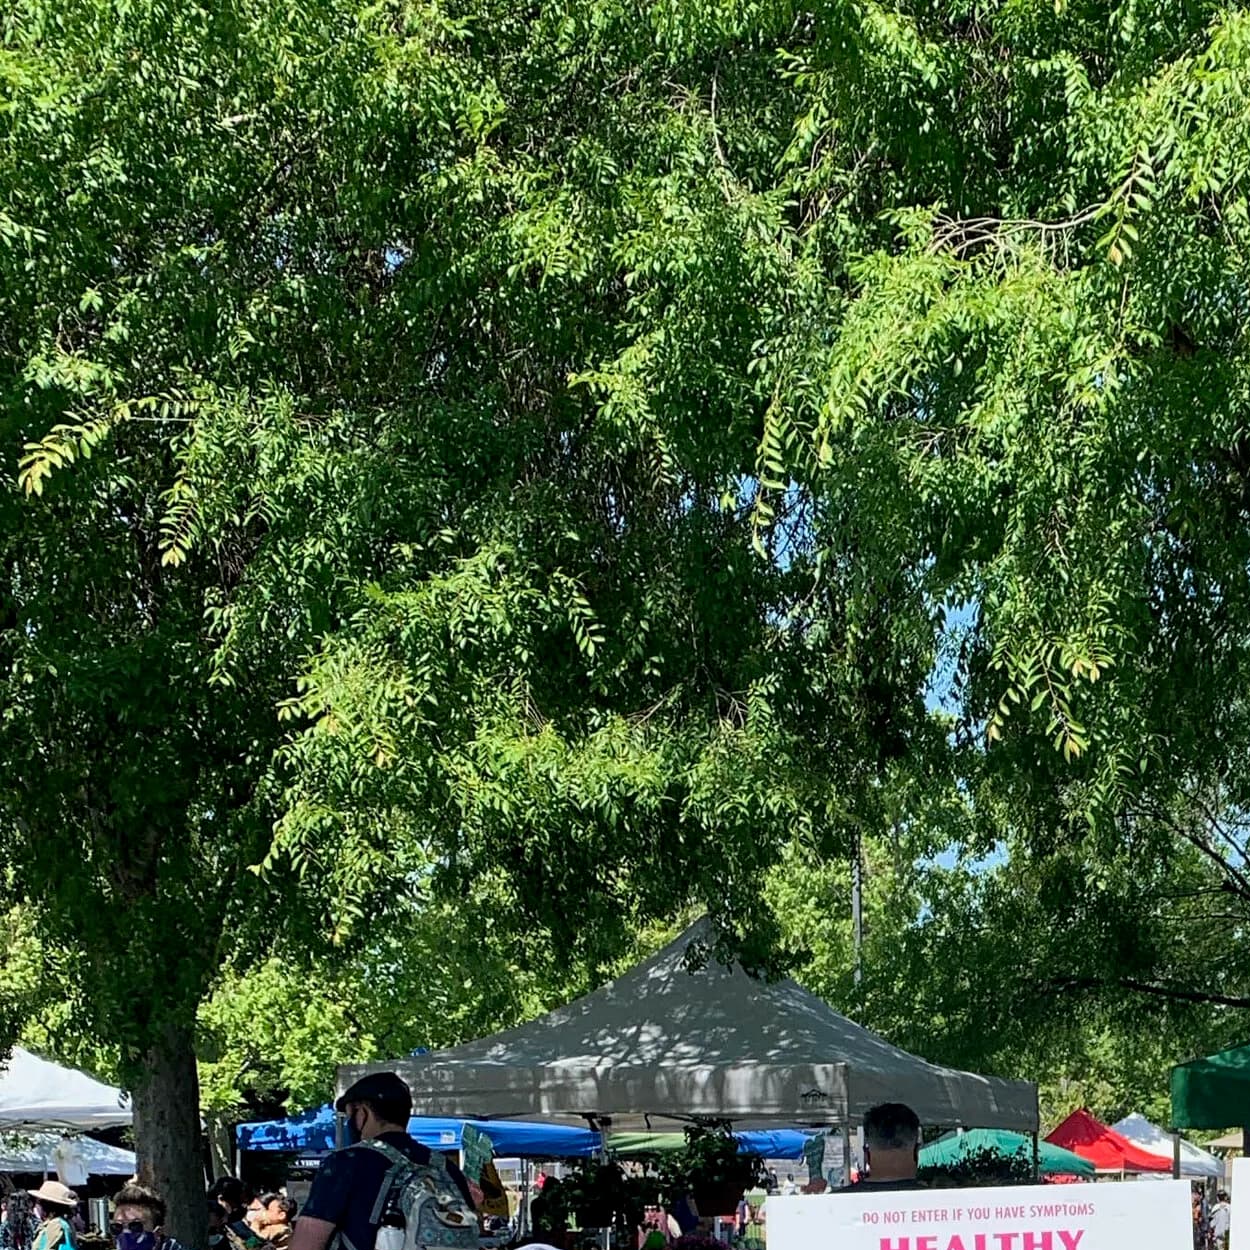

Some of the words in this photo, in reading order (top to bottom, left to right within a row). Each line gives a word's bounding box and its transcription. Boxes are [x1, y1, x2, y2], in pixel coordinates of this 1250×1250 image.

[863, 1212, 879, 1224] DO
[884, 1211, 906, 1224] NOT
[912, 1209, 948, 1222] ENTER
[953, 1209, 962, 1220] IF
[968, 1208, 990, 1220] YOU
[995, 1206, 1024, 1219] HAVE
[1030, 1203, 1094, 1217] SYMPTOMS
